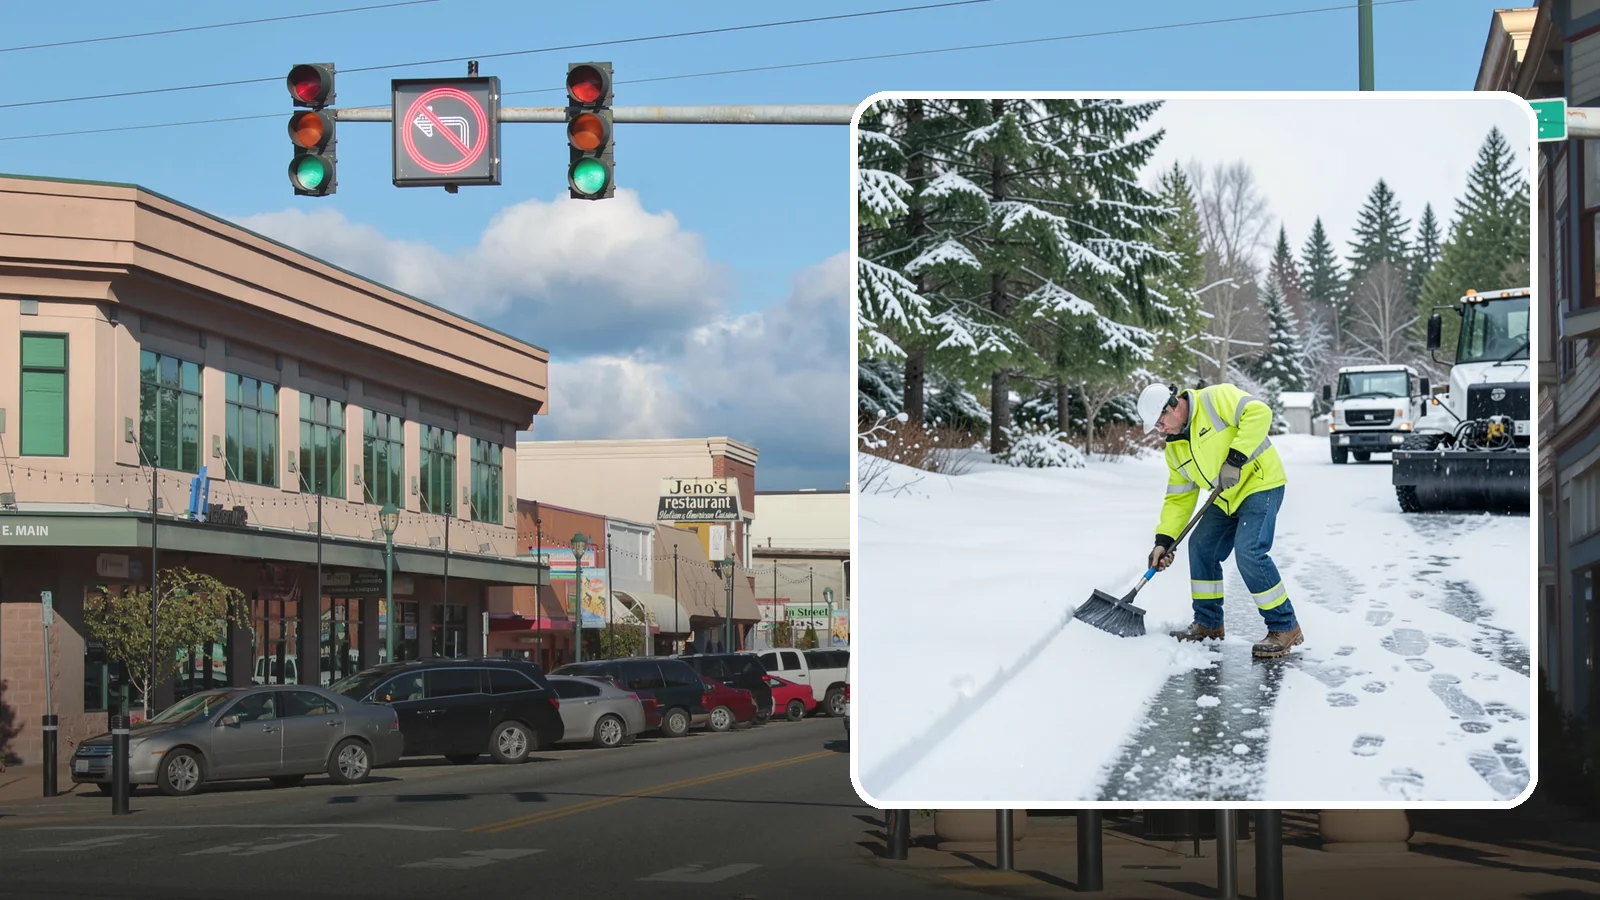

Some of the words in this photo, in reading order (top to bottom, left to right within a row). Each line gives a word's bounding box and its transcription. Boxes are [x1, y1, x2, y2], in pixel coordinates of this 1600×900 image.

[670, 480, 727, 494] Jeno's
[665, 497, 731, 509] restaurant
[686, 510, 714, 519] American
[715, 510, 737, 519] Cuisine
[2, 525, 13, 536] E.
[15, 525, 49, 536] MAIN
[797, 607, 829, 617] Street
[791, 619, 824, 627] lass
